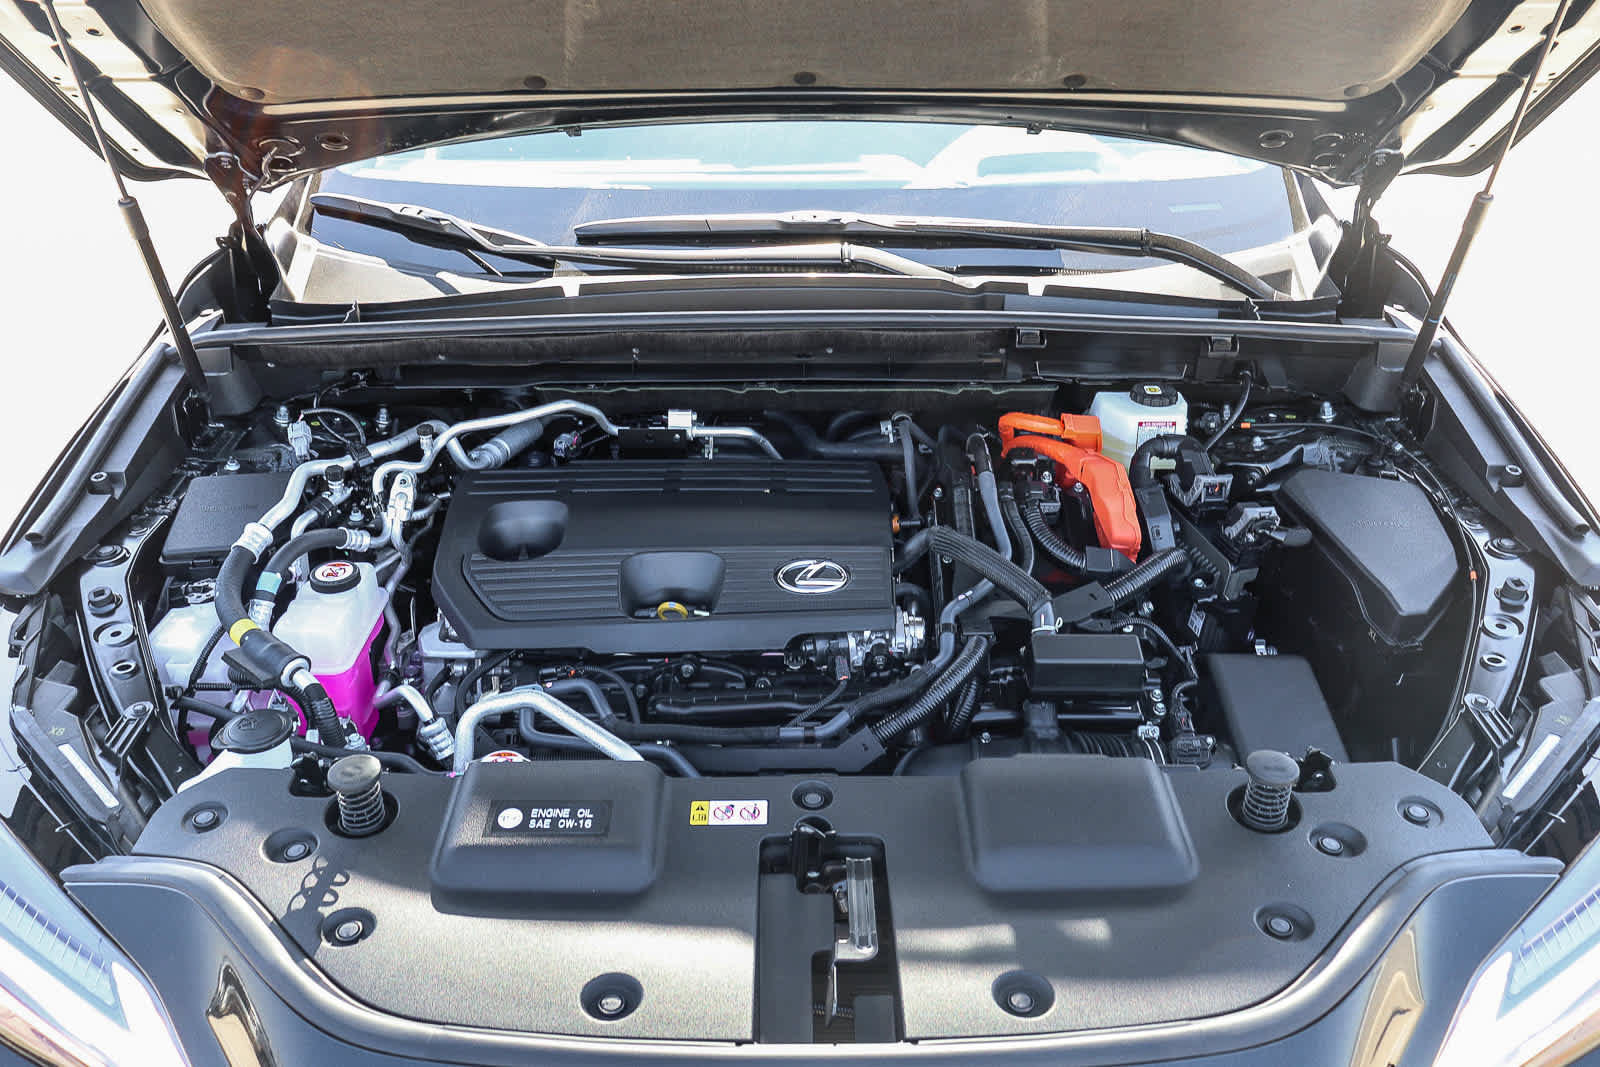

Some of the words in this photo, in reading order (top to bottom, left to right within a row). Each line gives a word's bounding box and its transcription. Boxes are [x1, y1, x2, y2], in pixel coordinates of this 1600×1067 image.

[530, 808, 570, 818] ENGINE
[577, 808, 594, 818] OIL
[528, 819, 551, 829] SAE
